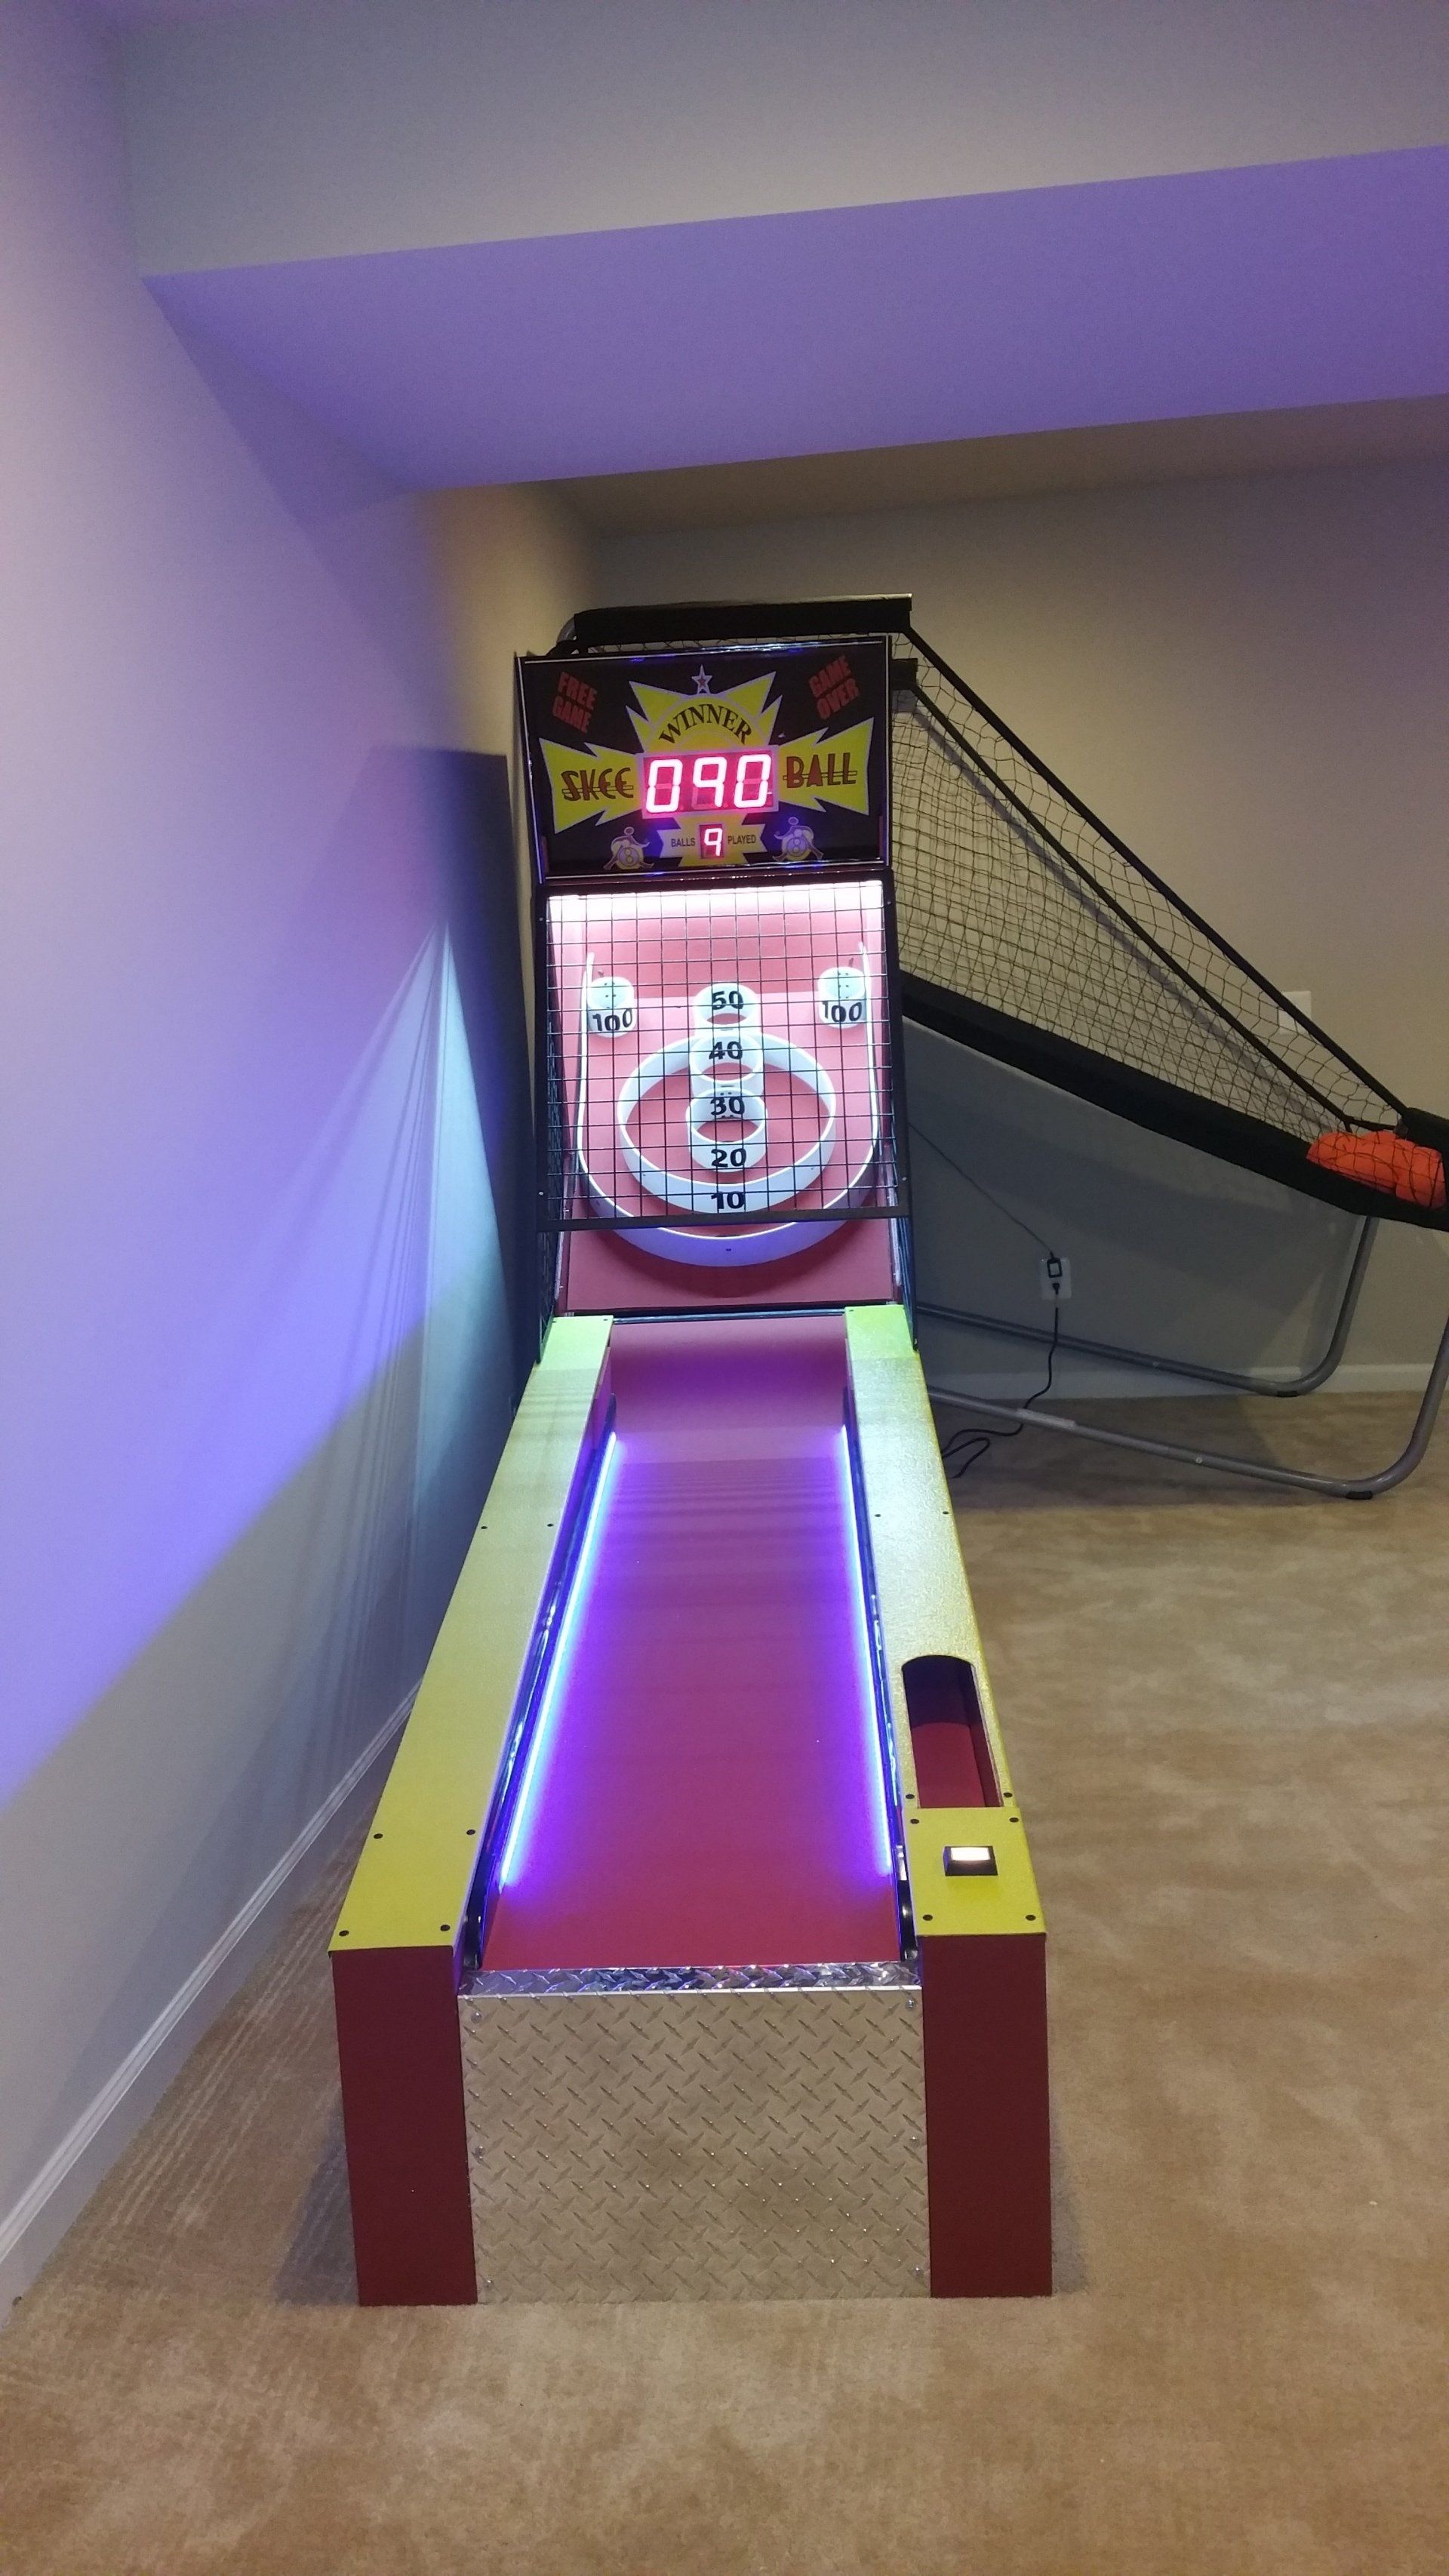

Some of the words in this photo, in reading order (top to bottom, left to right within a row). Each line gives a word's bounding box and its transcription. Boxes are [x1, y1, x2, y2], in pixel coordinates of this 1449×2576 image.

[809, 654, 851, 694] GAME
[558, 671, 598, 710] FREE
[816, 679, 860, 719] OVER
[552, 696, 593, 734] GAME
[659, 703, 752, 745] WINNER
[561, 768, 634, 801] SKEE
[783, 752, 857, 789] BALL
[646, 754, 771, 813] 090
[670, 838, 696, 848] BALLS
[728, 835, 756, 845] PLAYED
[704, 827, 722, 857] 9
[711, 991, 743, 1010] 50
[822, 1002, 863, 1022] 100
[592, 1009, 633, 1033] 100
[709, 1041, 743, 1060] 40
[711, 1097, 745, 1116] 30
[711, 1147, 746, 1168] 20
[711, 1192, 746, 1209] 10
